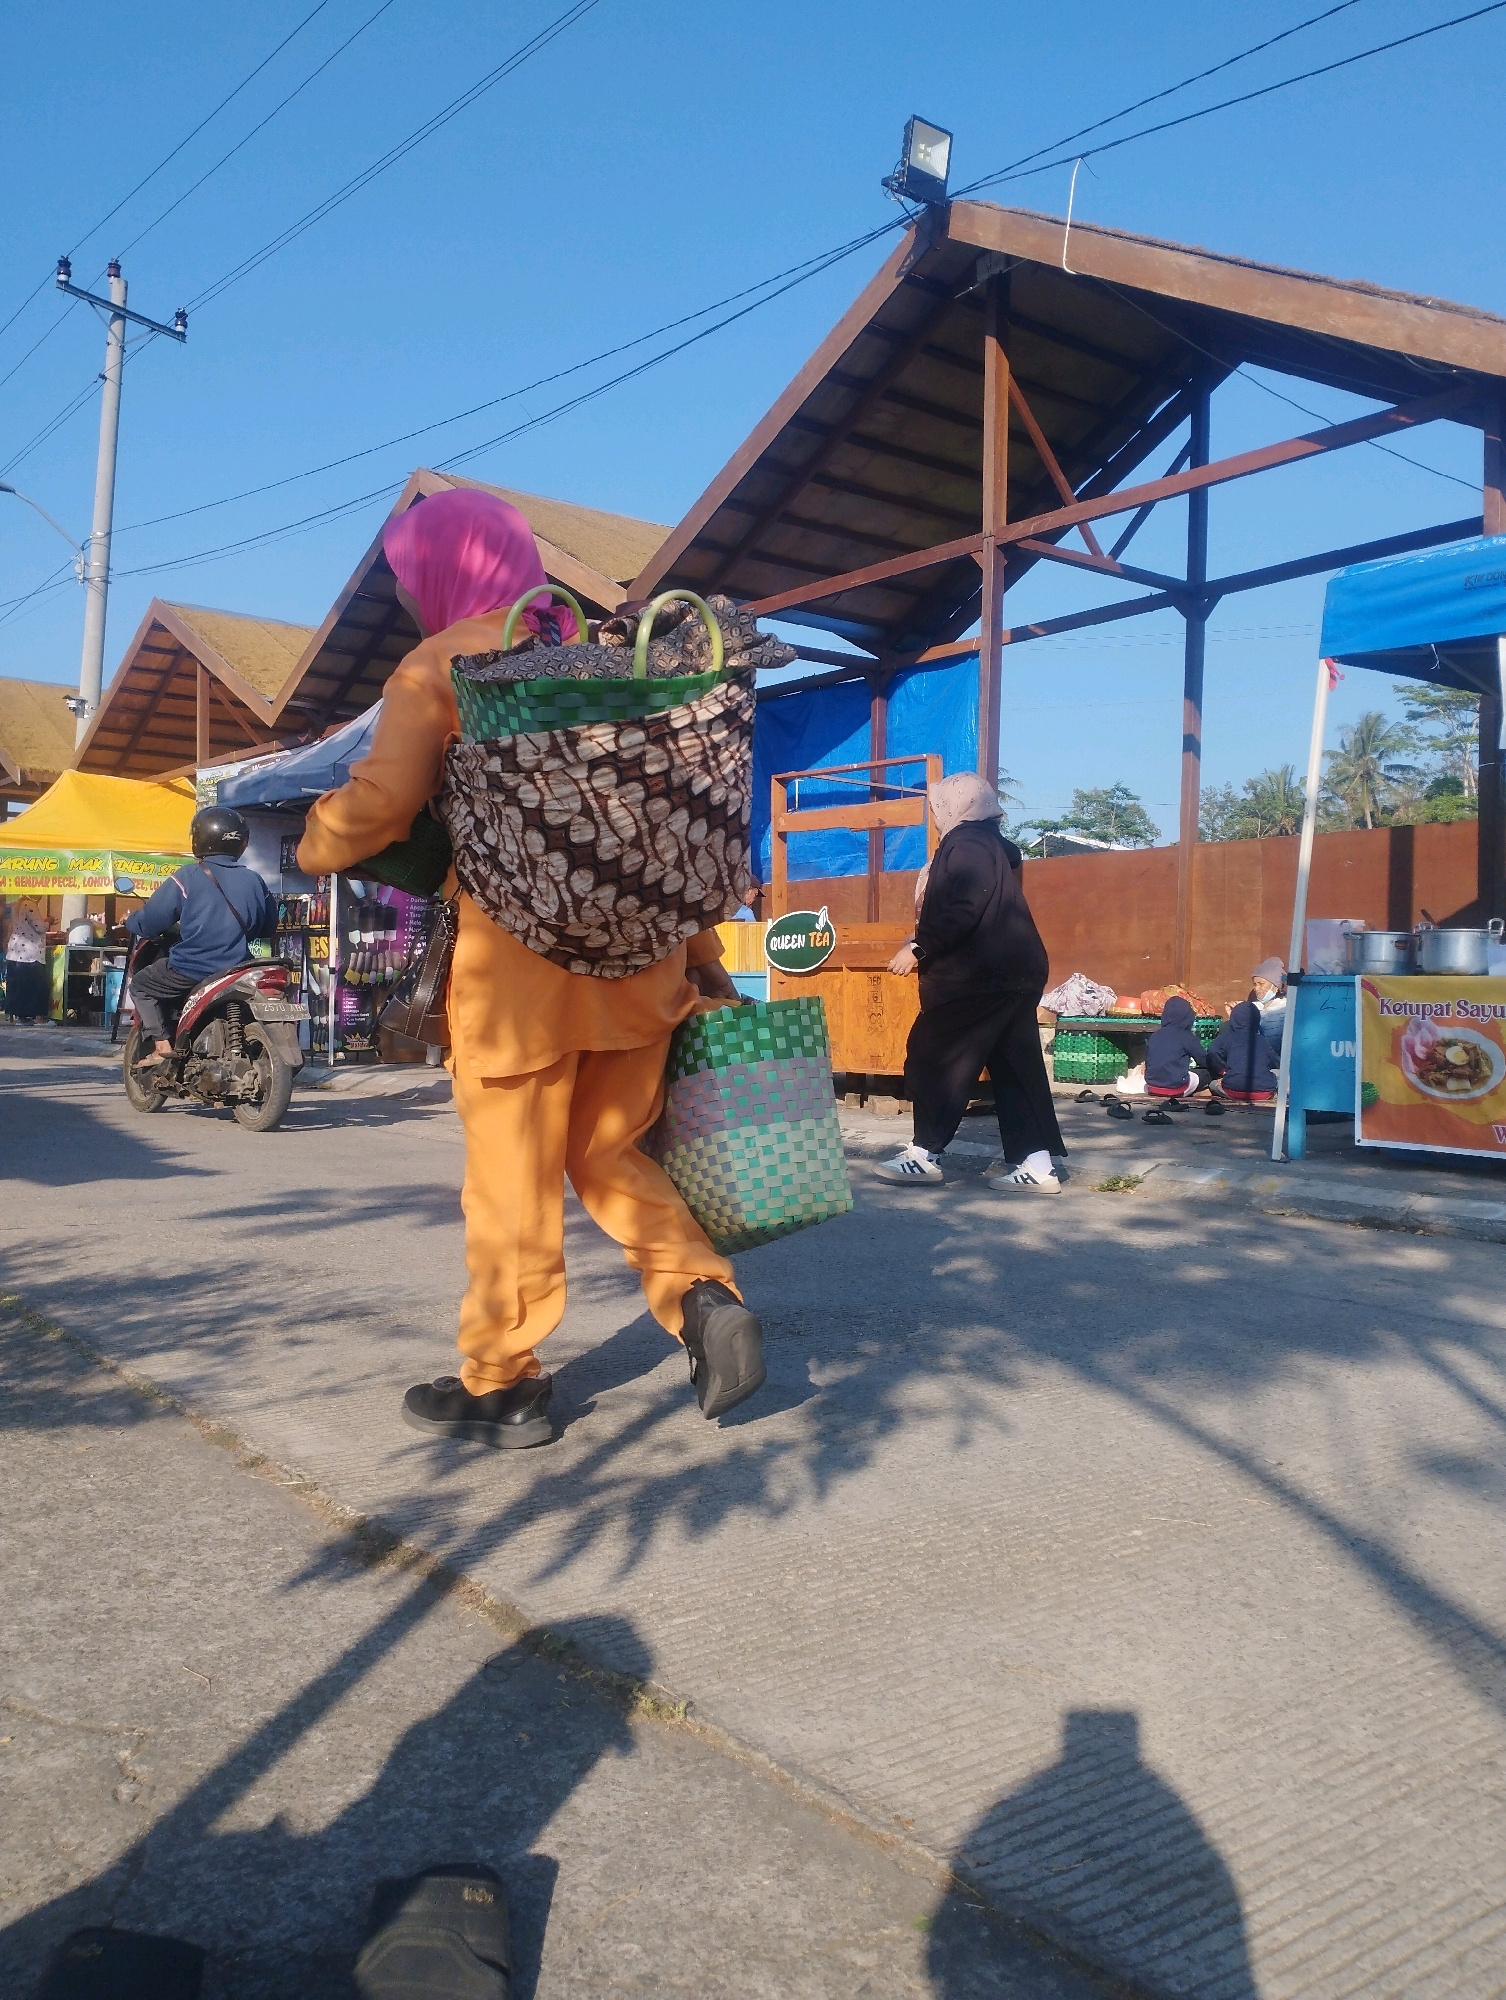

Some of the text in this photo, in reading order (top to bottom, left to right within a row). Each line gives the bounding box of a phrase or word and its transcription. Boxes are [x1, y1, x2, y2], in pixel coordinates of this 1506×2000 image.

[68, 857, 103, 871] MAK
[770, 931, 830, 951] QUEEN TEA
[1379, 998, 1506, 1022] Ketupat Sayu
